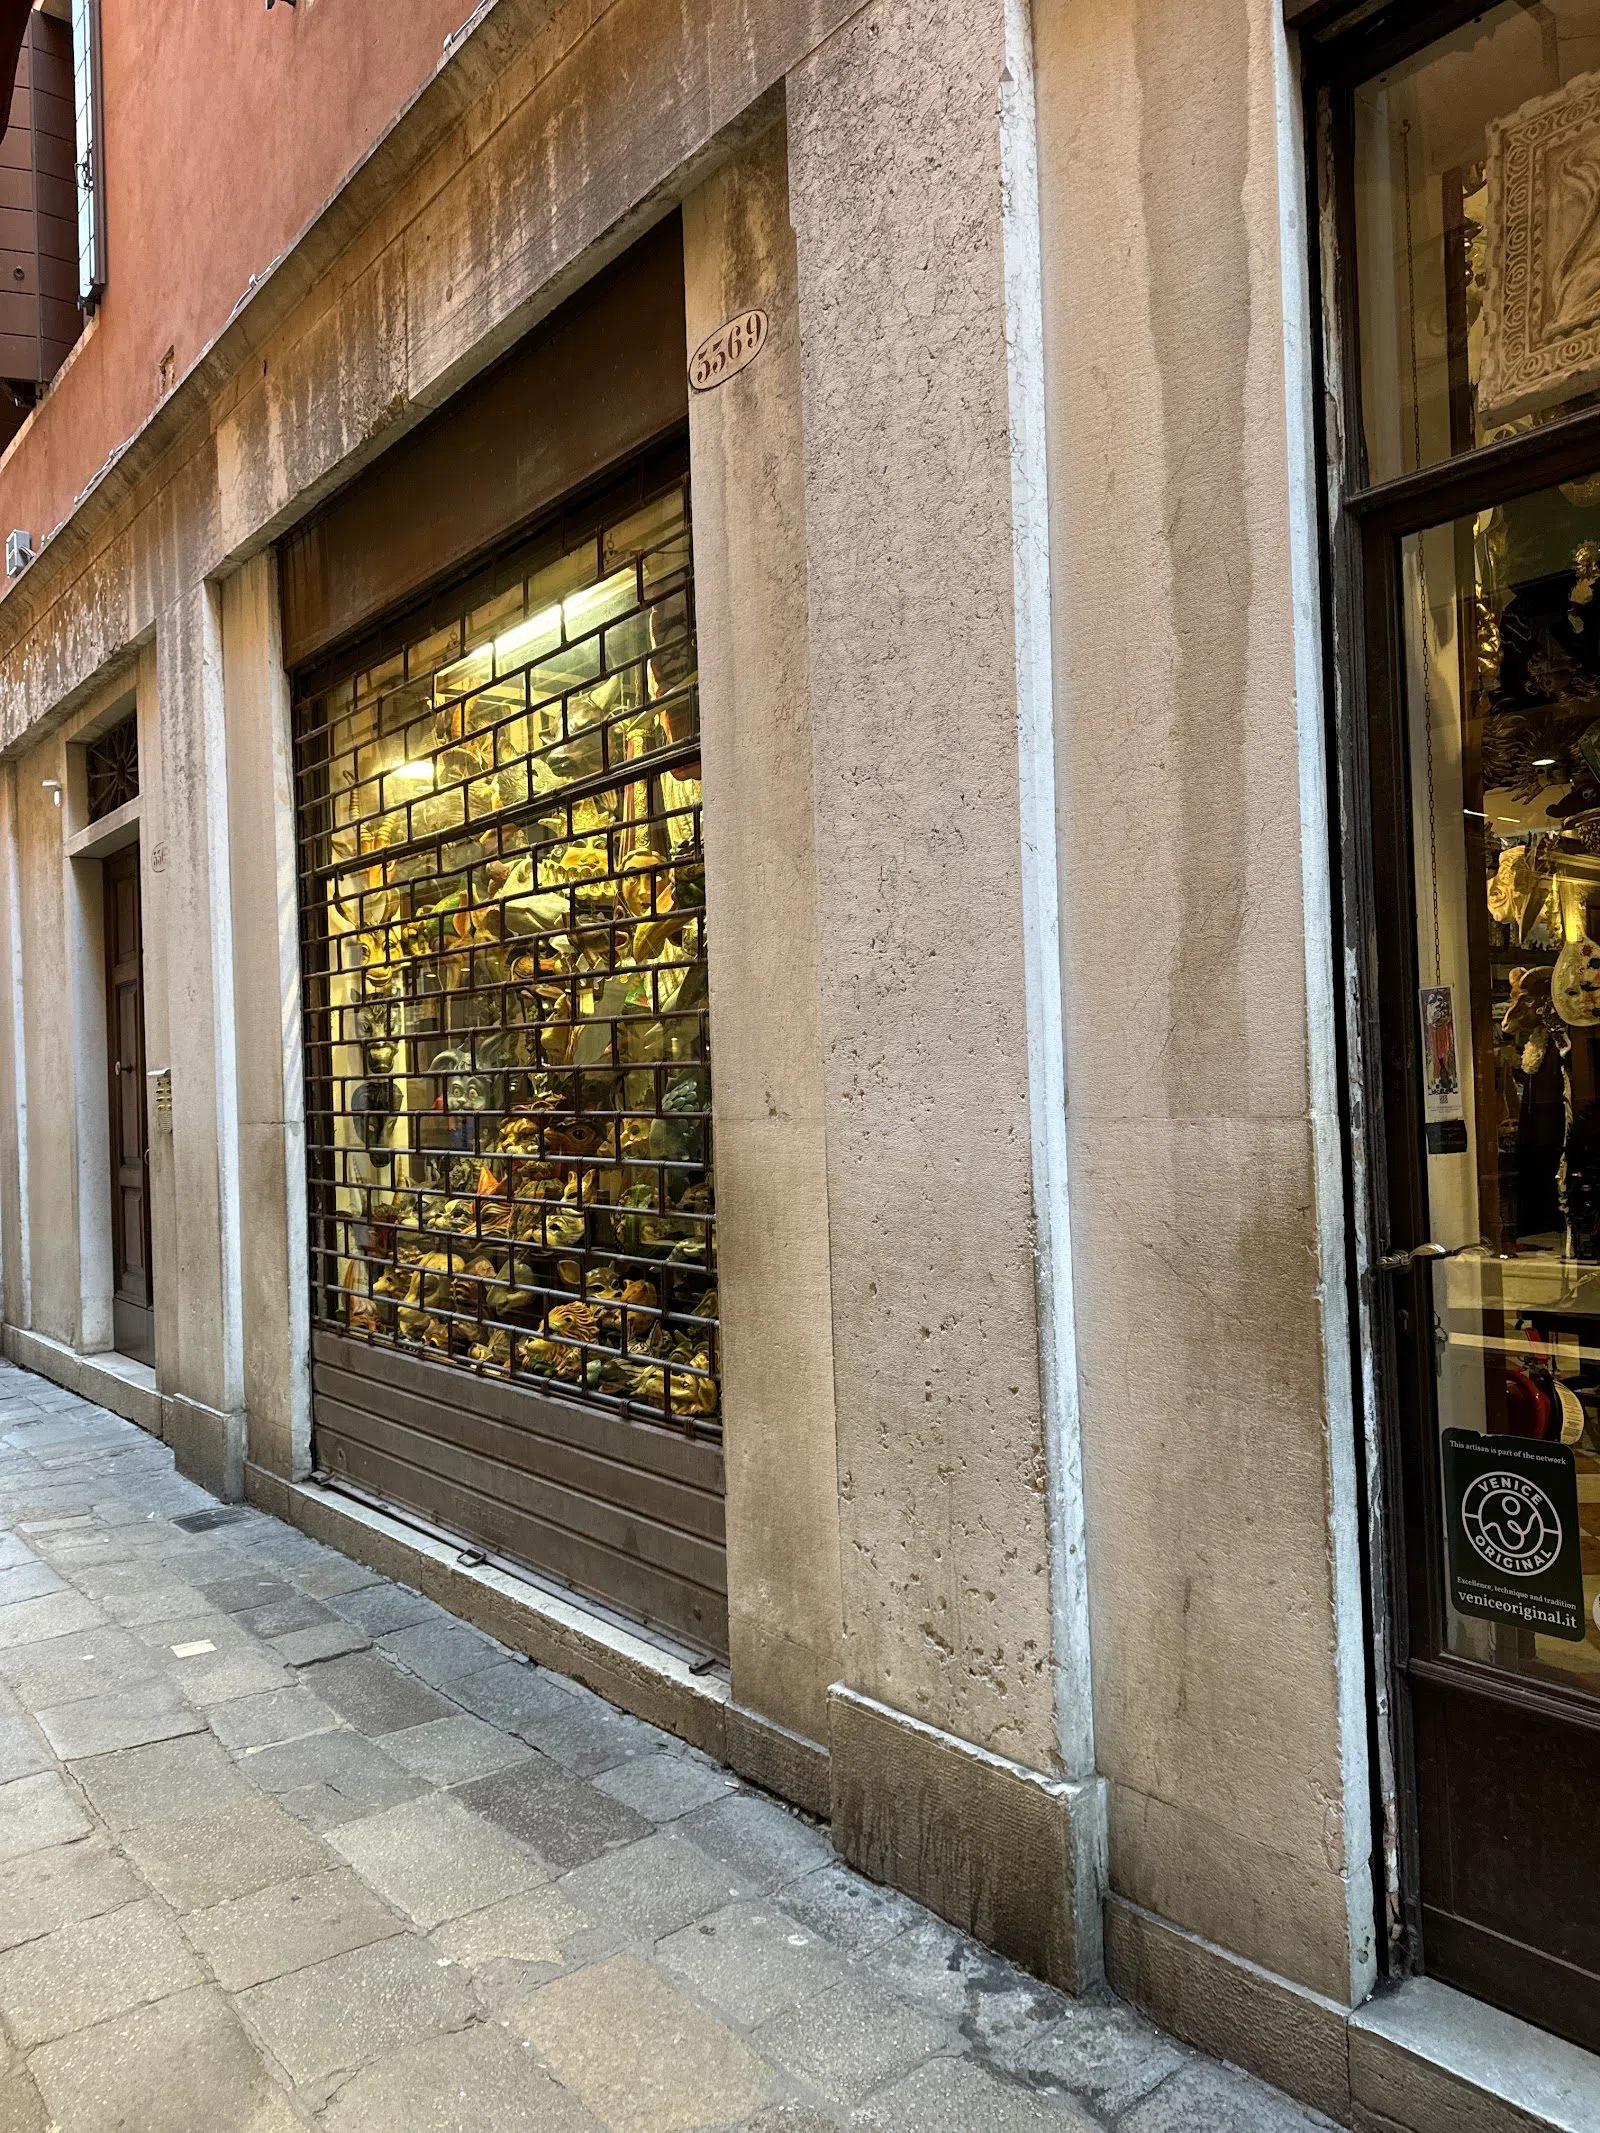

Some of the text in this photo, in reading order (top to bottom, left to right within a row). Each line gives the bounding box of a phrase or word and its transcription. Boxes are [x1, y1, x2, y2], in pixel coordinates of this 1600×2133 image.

[697, 313, 762, 384] 5569
[1449, 1440, 1465, 1449] This
[1465, 1443, 1490, 1453] artisan
[1498, 1449, 1513, 1457] part
[1513, 1450, 1522, 1458] of
[1522, 1452, 1535, 1460] the
[1535, 1455, 1567, 1465] network
[1478, 1477, 1543, 1506] VENICE
[1475, 1535, 1552, 1571] ORIGINAL
[1457, 1576, 1577, 1610] Excellence, technique and tradition
[1458, 1591, 1577, 1628] veniceoriginal.it
